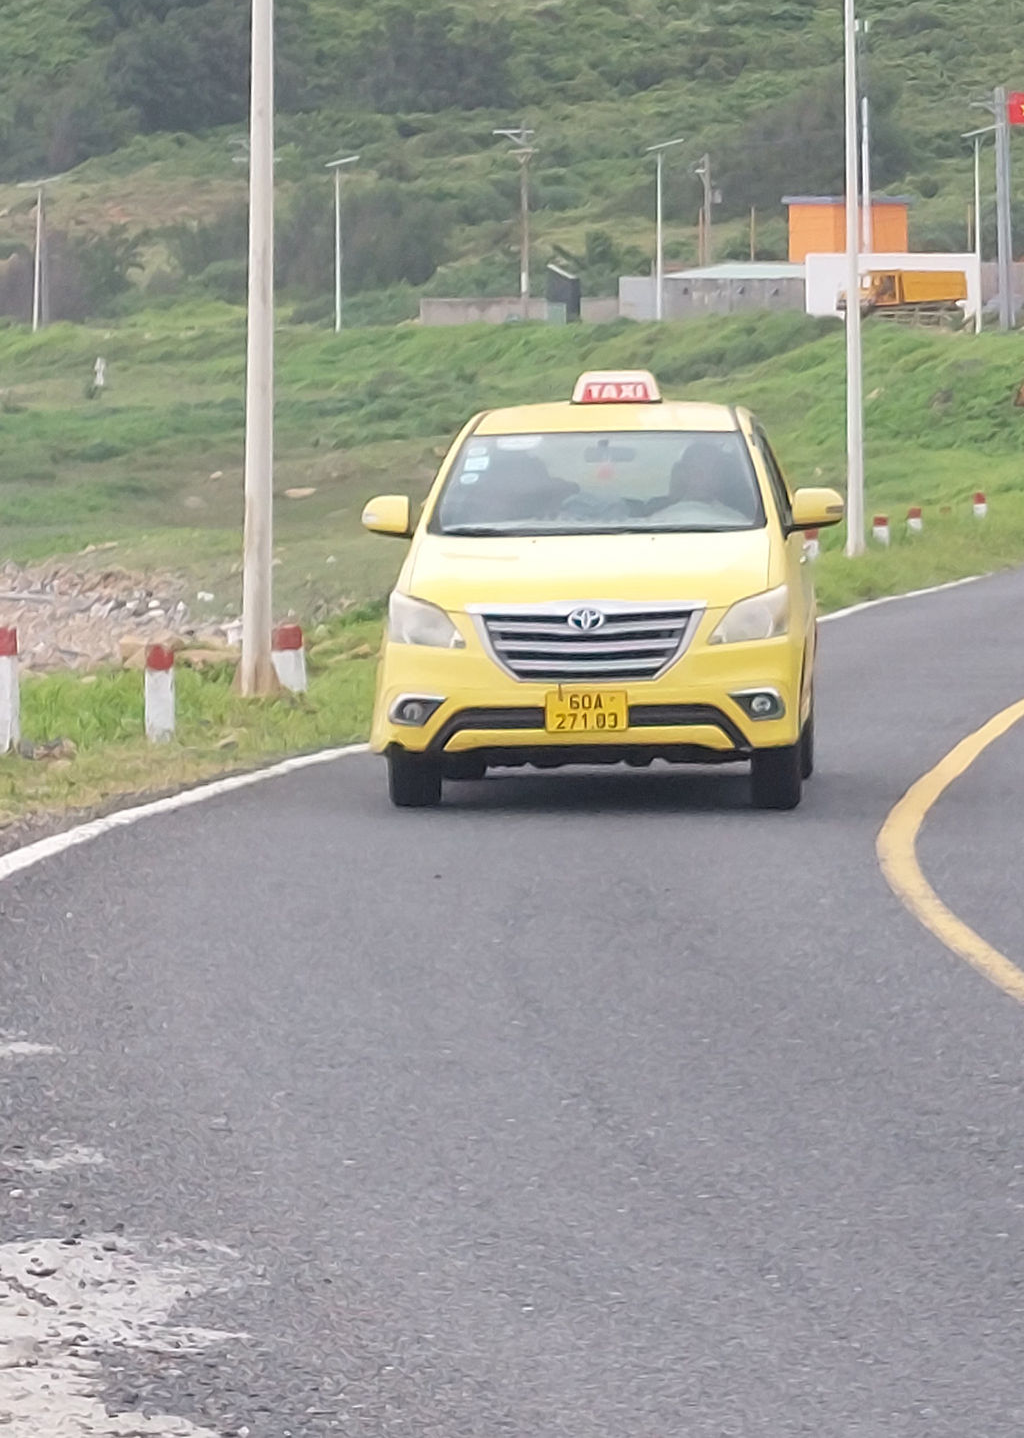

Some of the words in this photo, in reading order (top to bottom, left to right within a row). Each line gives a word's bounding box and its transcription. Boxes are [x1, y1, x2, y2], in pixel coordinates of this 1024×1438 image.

[587, 384, 644, 400] TAXI
[570, 694, 603, 710] 60A
[555, 712, 618, 729] 271.03
